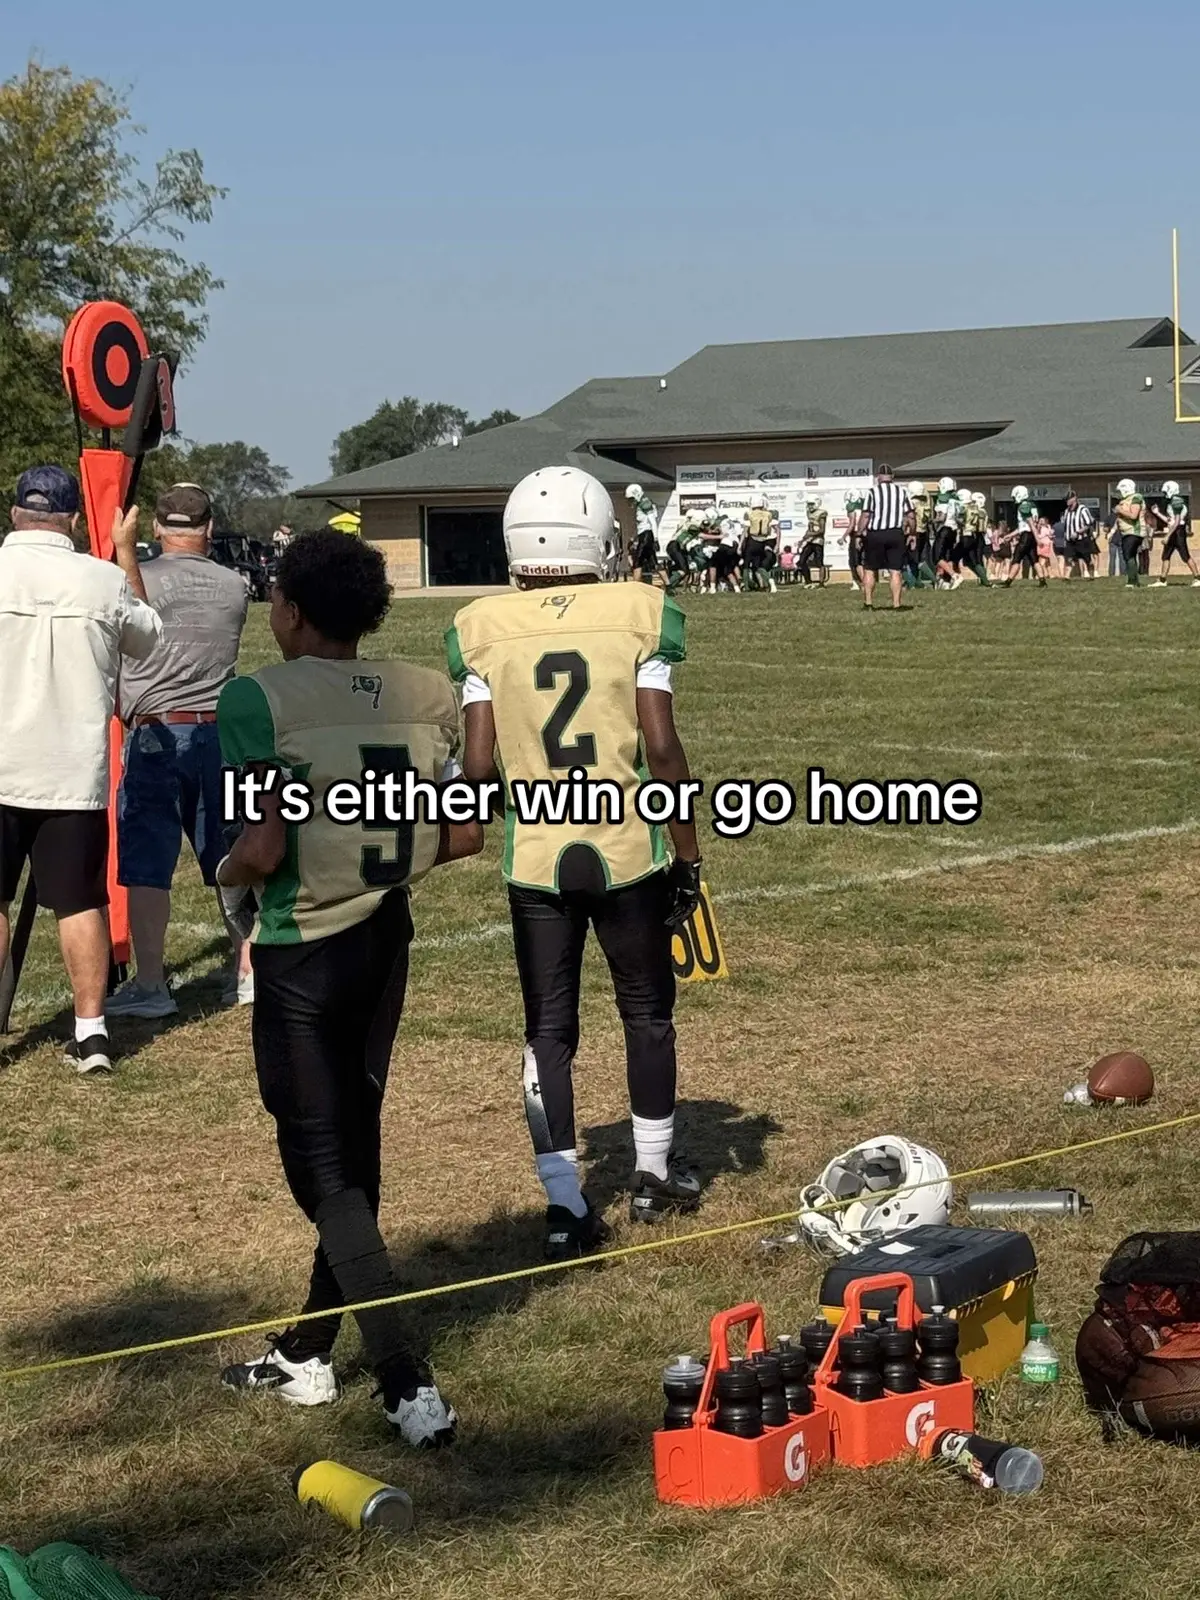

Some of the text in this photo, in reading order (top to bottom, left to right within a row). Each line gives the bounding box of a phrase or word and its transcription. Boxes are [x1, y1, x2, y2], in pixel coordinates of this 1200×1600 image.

[680, 471, 715, 479] PRESTO
[832, 468, 870, 477] CULLEN
[718, 499, 752, 509] FASTENA
[521, 565, 569, 575] Riddell
[533, 648, 599, 770] 2
[1022, 1363, 1047, 1375] Sprite
[904, 1400, 936, 1448] G
[941, 1432, 969, 1460] G
[784, 1431, 806, 1483] G
